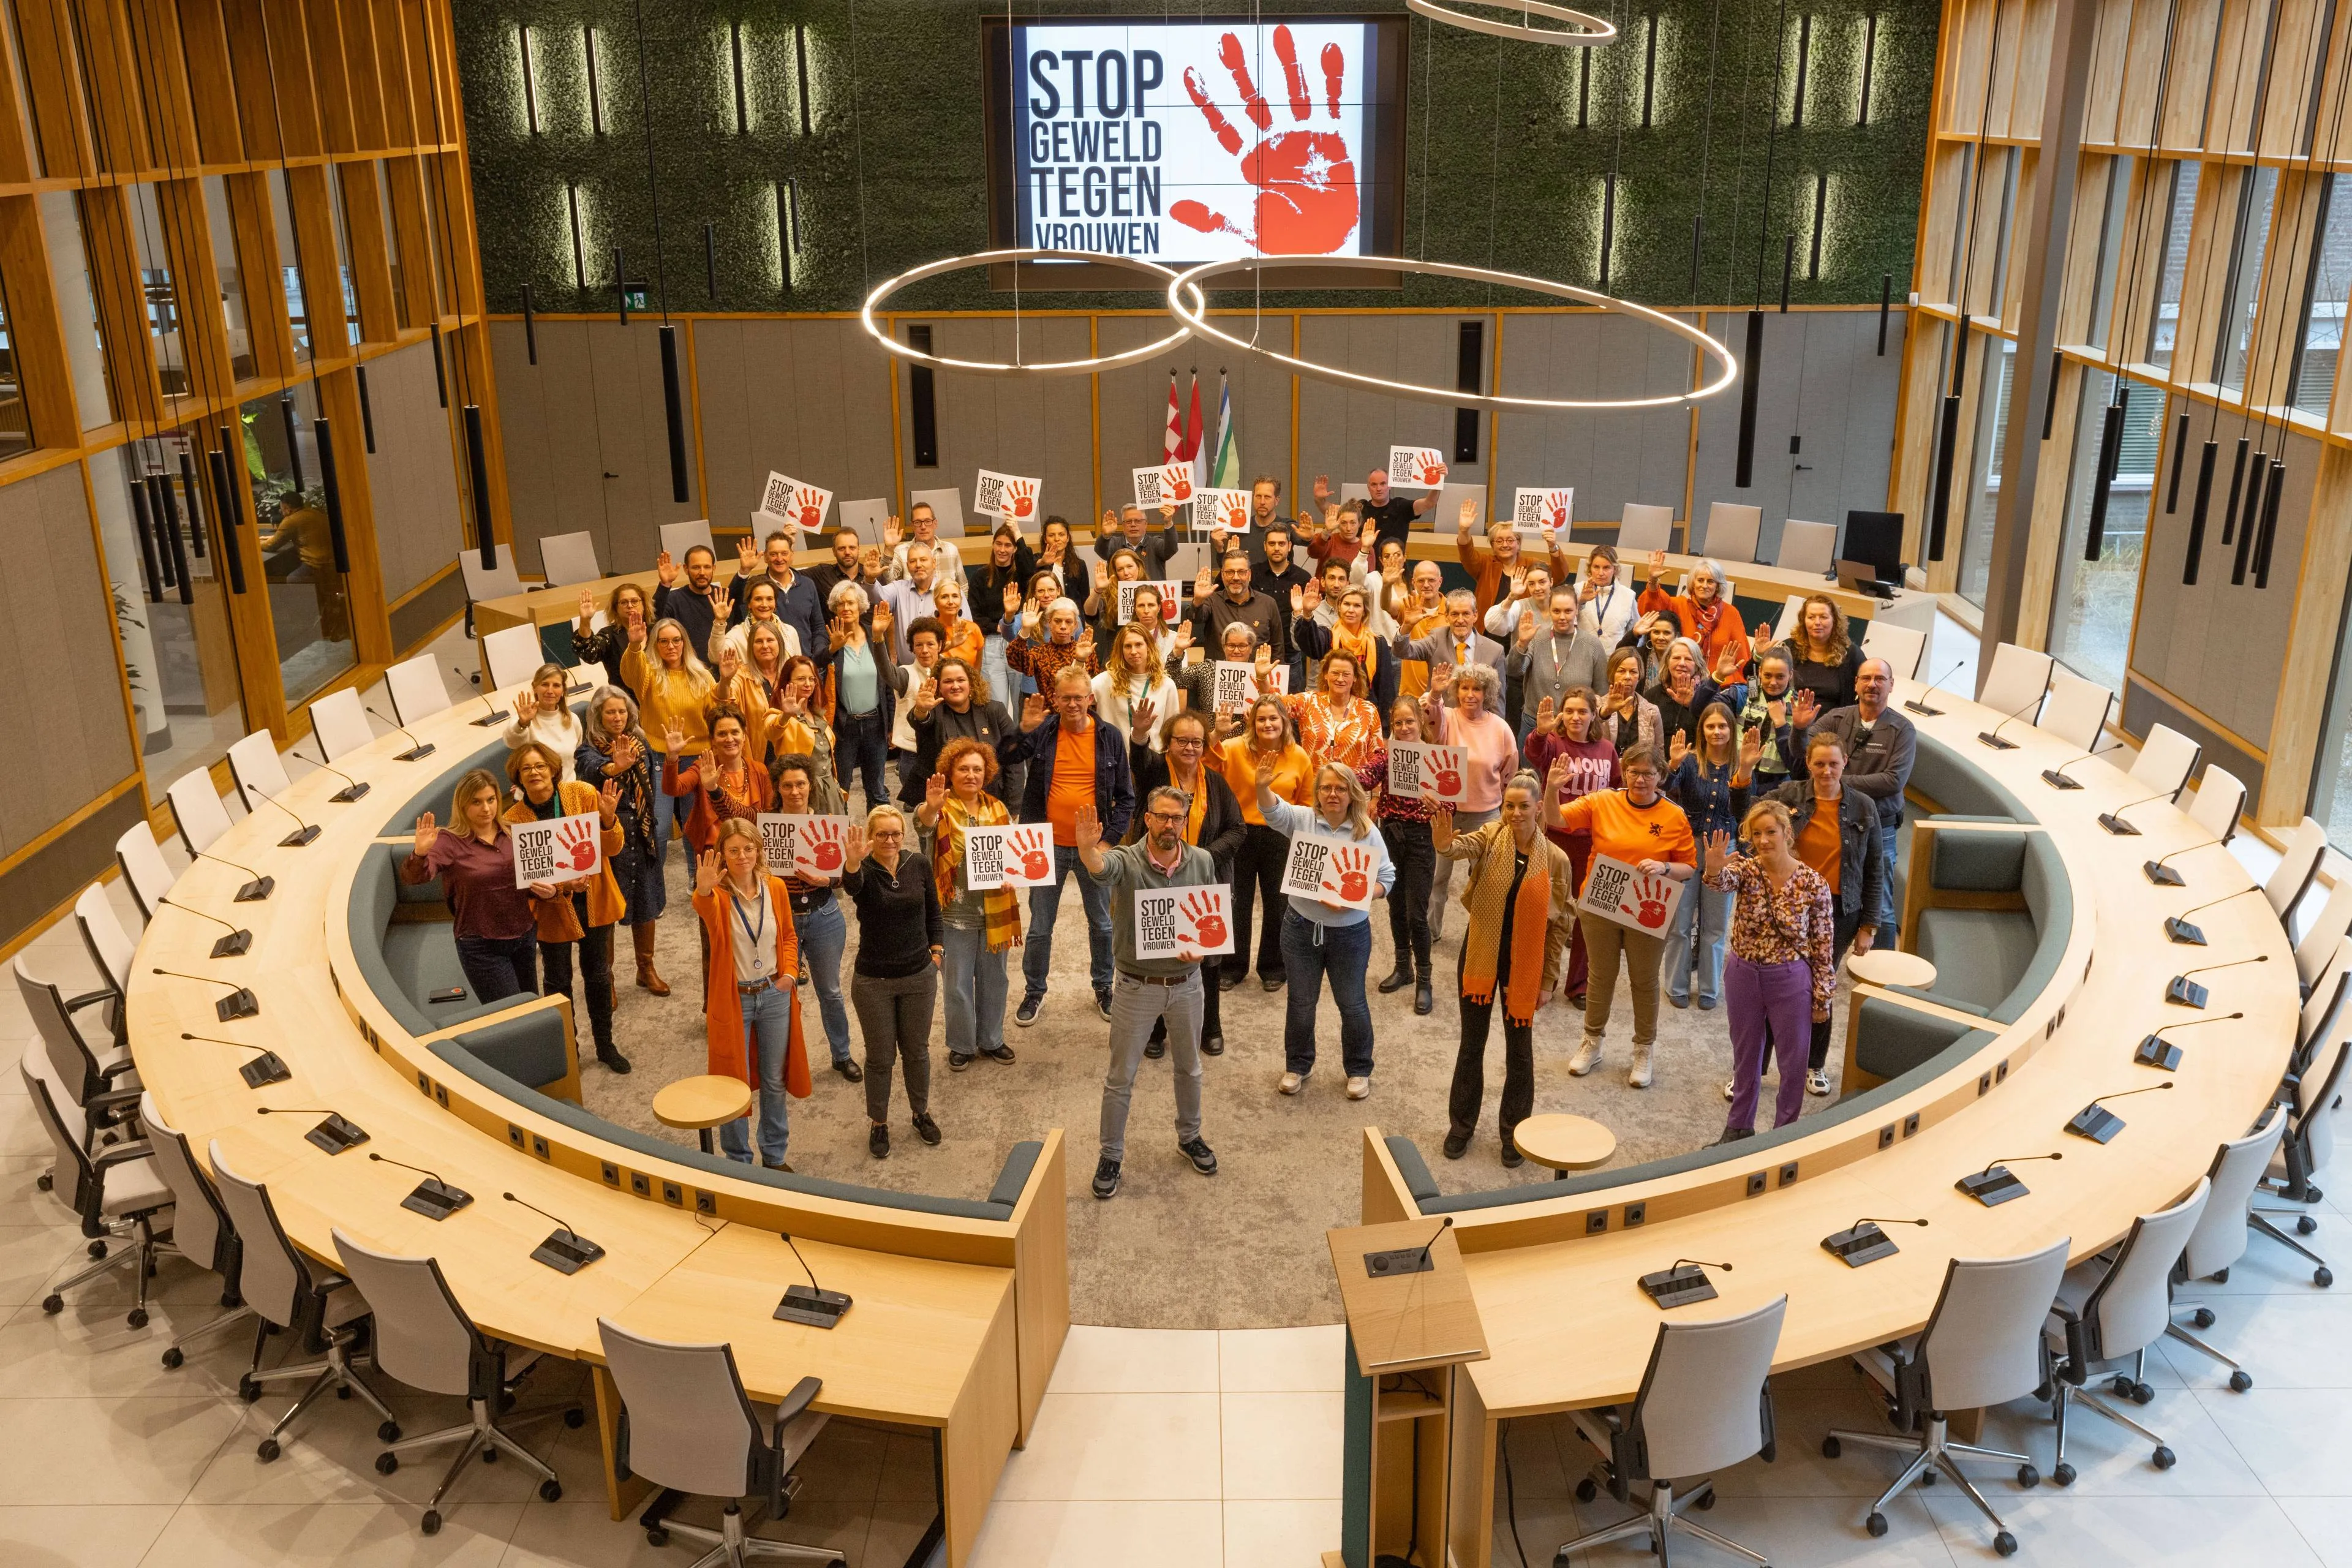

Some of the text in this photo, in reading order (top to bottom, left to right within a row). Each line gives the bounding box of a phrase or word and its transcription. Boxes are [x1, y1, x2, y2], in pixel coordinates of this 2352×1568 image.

[1030, 49, 1163, 120] STOP
[1031, 121, 1161, 162] GEWELD
[1031, 166, 1161, 217] TEGEN
[1036, 222, 1159, 254] VROUWEN
[1394, 452, 1414, 462] STOP
[981, 477, 1004, 491] STOP
[1137, 473, 1159, 484] STOP
[771, 479, 794, 495] STOP
[981, 488, 1001, 498] GEWELD
[769, 489, 790, 503] GEWELD
[980, 494, 1001, 507] TEGEN
[1139, 489, 1160, 499] TEGEN
[1197, 494, 1218, 505] STOP
[1520, 495, 1542, 506] STOP
[767, 496, 788, 511] TEGEN
[979, 502, 999, 512] VROUWEN
[765, 505, 785, 517] VROUWEN
[1518, 513, 1540, 522] TEGEN
[1220, 669, 1246, 682] STOP
[1219, 681, 1245, 690] GEWELD
[1219, 690, 1244, 701] TEGEN
[1393, 748, 1420, 764] STOP
[1393, 762, 1419, 774] GEWELD
[1393, 771, 1419, 784] TEGEN
[1393, 781, 1418, 792] VROUWEN
[763, 823, 795, 838] STOP
[519, 830, 551, 849] STOP
[763, 838, 794, 848] GEWELD
[971, 835, 1002, 851] STOP
[520, 845, 552, 859] GEWELD
[972, 851, 1002, 861] GEWELD
[1295, 841, 1328, 861] STOP
[521, 856, 553, 871] TEGEN
[973, 861, 1003, 873] TEGEN
[1293, 856, 1324, 871] GEWELD
[522, 869, 554, 880] VROUWEN
[974, 873, 1003, 882] VROUWEN
[1291, 866, 1322, 884] TEGEN
[1597, 864, 1630, 885] STOP
[1289, 879, 1319, 892] VROUWEN
[1593, 877, 1624, 895] GEWELD
[1590, 886, 1621, 906] TEGEN
[1141, 898, 1175, 916] STOP
[1588, 896, 1617, 913] VROUWEN
[1142, 915, 1175, 927] GEWELD
[1142, 926, 1175, 941] TEGEN
[1143, 940, 1175, 951] VROUWEN
